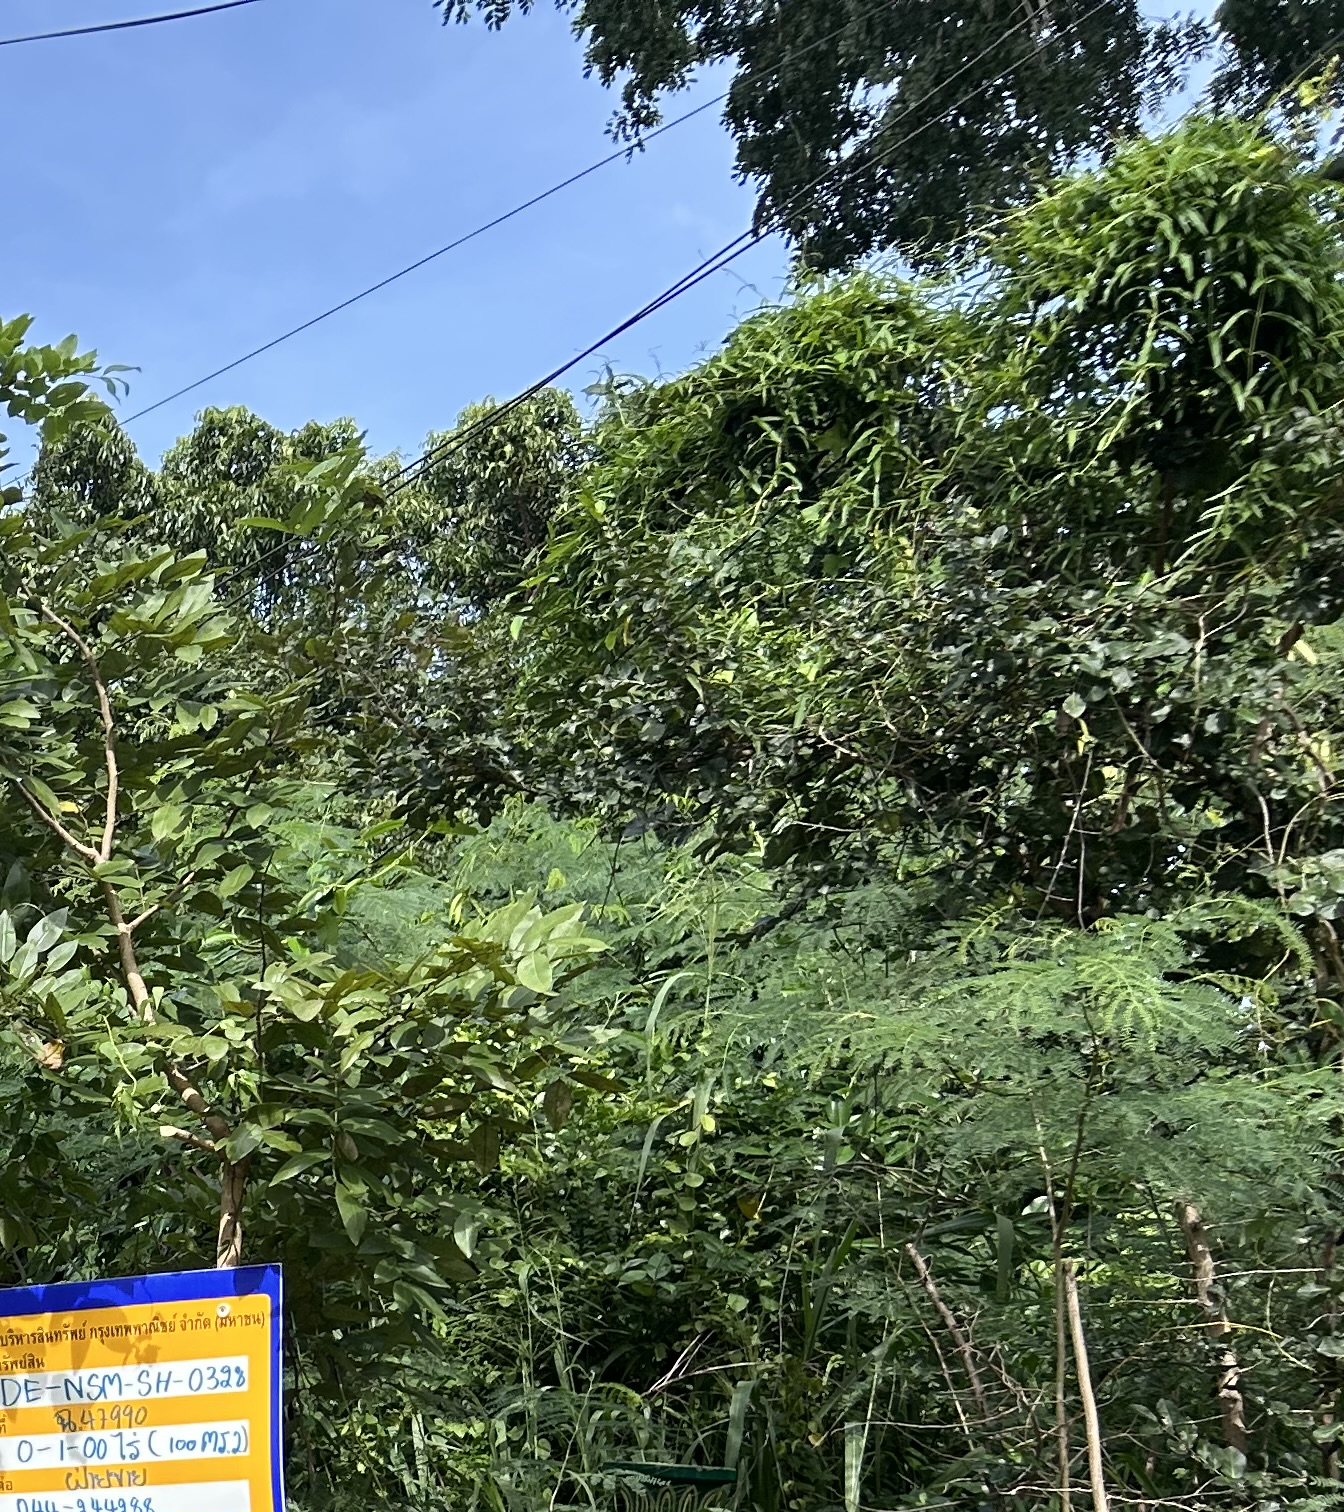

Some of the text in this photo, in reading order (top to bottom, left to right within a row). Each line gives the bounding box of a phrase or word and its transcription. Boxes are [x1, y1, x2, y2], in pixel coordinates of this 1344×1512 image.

[89, 1313, 177, 1345] กรุงเทพพาณิชย์
[179, 1312, 211, 1331] จำกัด
[215, 1311, 265, 1332] (มหาชน)
[0, 1365, 246, 1408] DE-NSM-SH-0328
